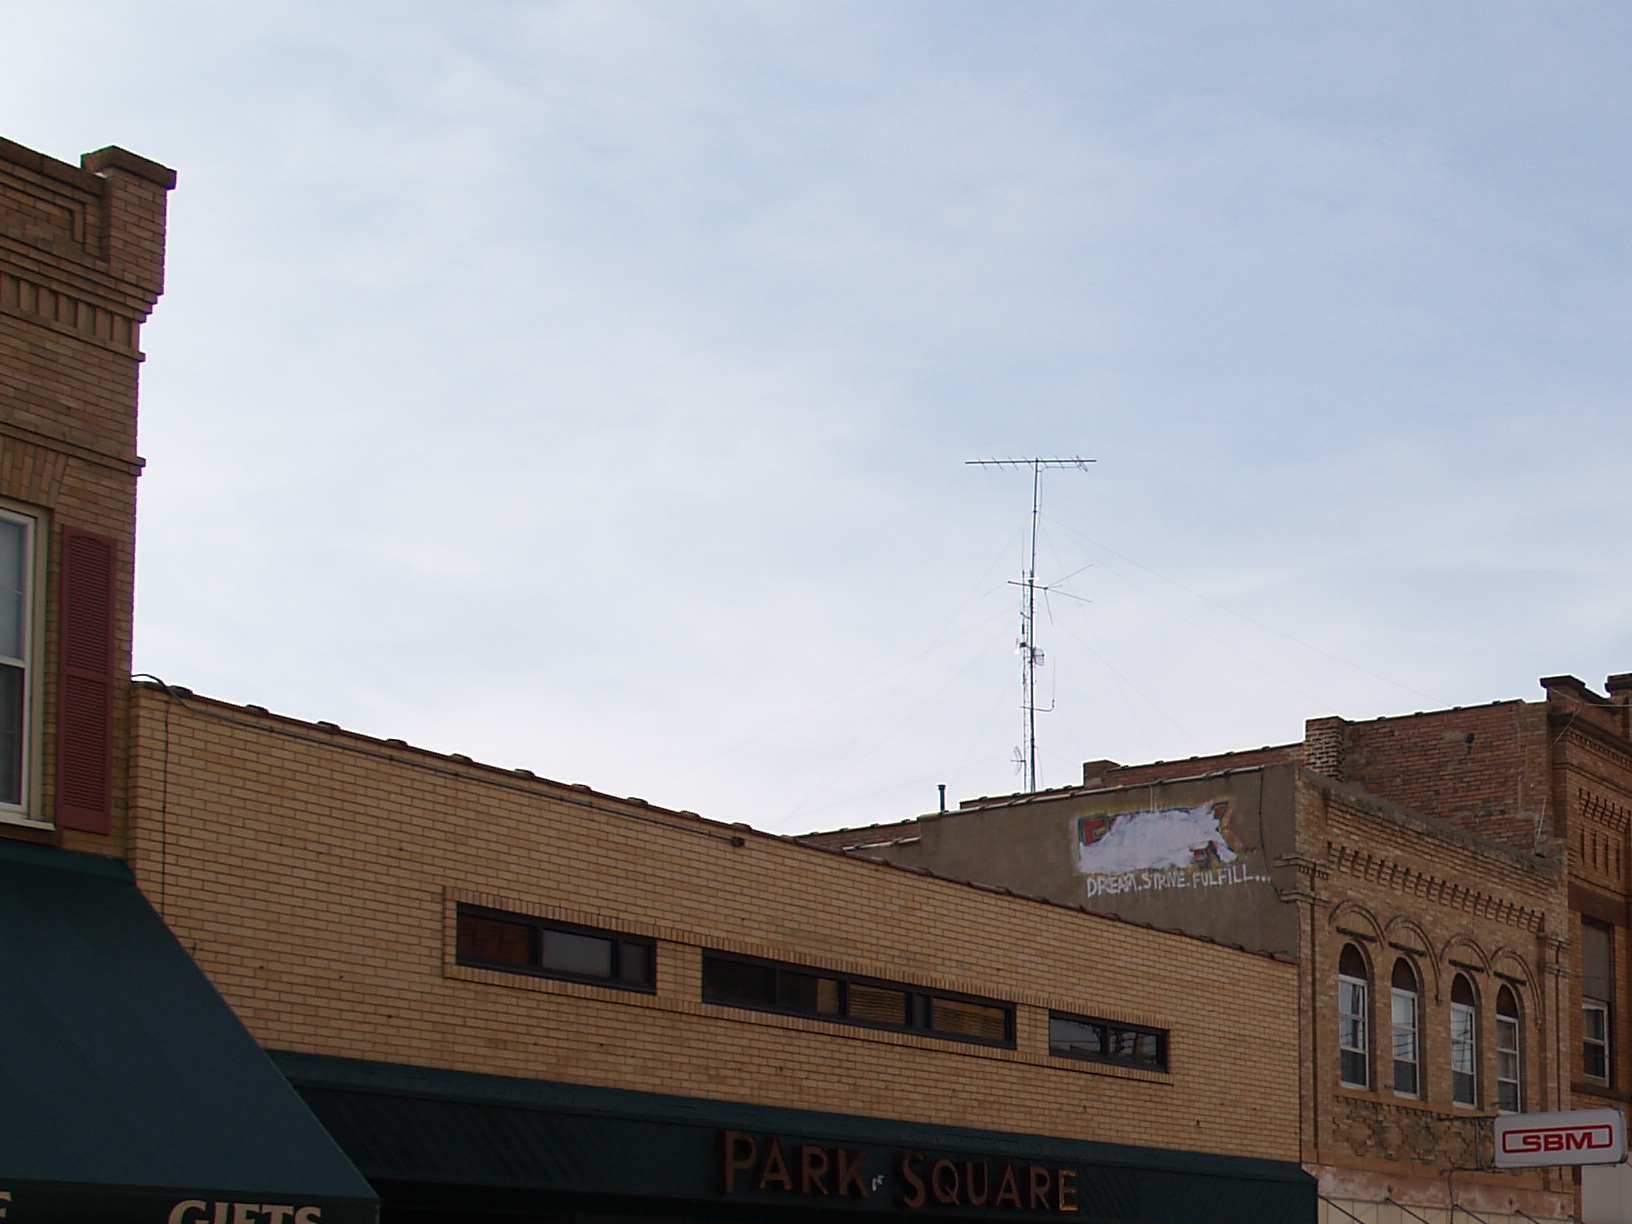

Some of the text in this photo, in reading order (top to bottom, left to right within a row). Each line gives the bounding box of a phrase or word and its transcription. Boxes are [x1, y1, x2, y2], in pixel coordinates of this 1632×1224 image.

[1522, 1131, 1593, 1152] SBM
[716, 1129, 1082, 1214] PARK SQUARE
